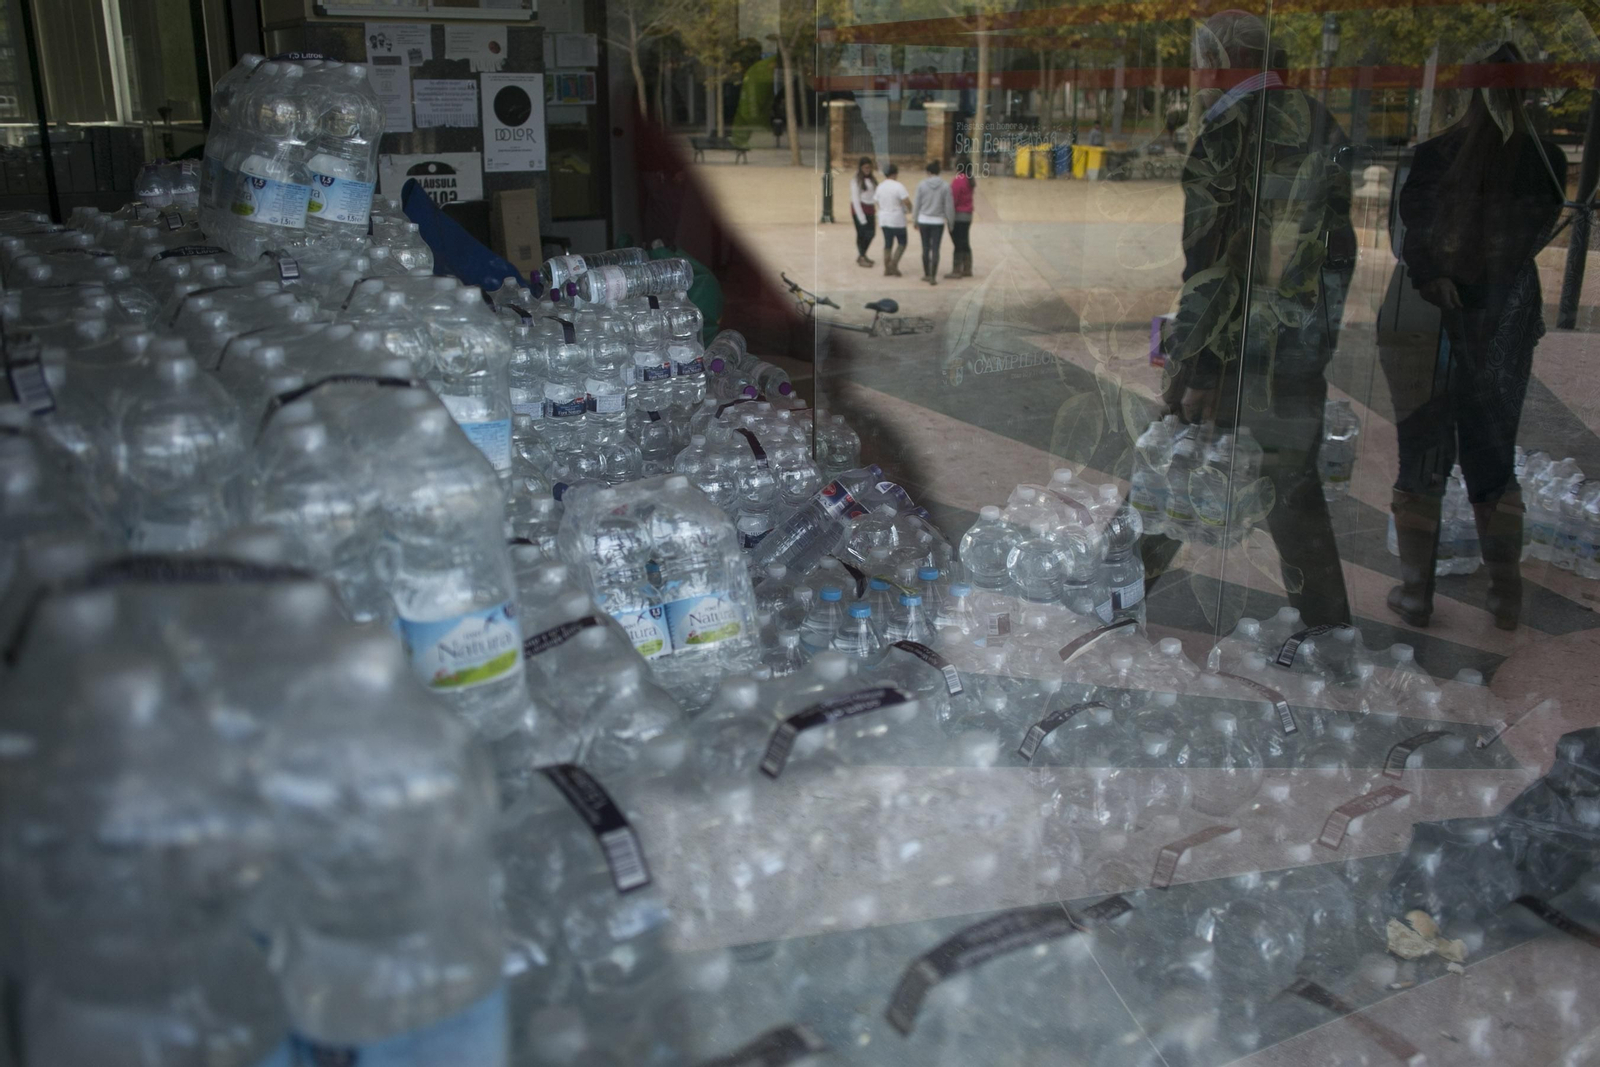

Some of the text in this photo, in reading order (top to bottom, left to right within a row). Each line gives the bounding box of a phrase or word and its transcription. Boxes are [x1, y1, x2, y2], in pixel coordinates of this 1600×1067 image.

[956, 121, 985, 131] Fiestas
[986, 123, 996, 131] en
[996, 121, 1018, 131] honor
[495, 128, 537, 144] DOLOR
[955, 132, 981, 154] San
[955, 162, 991, 180] 2018
[689, 609, 736, 627] Natura
